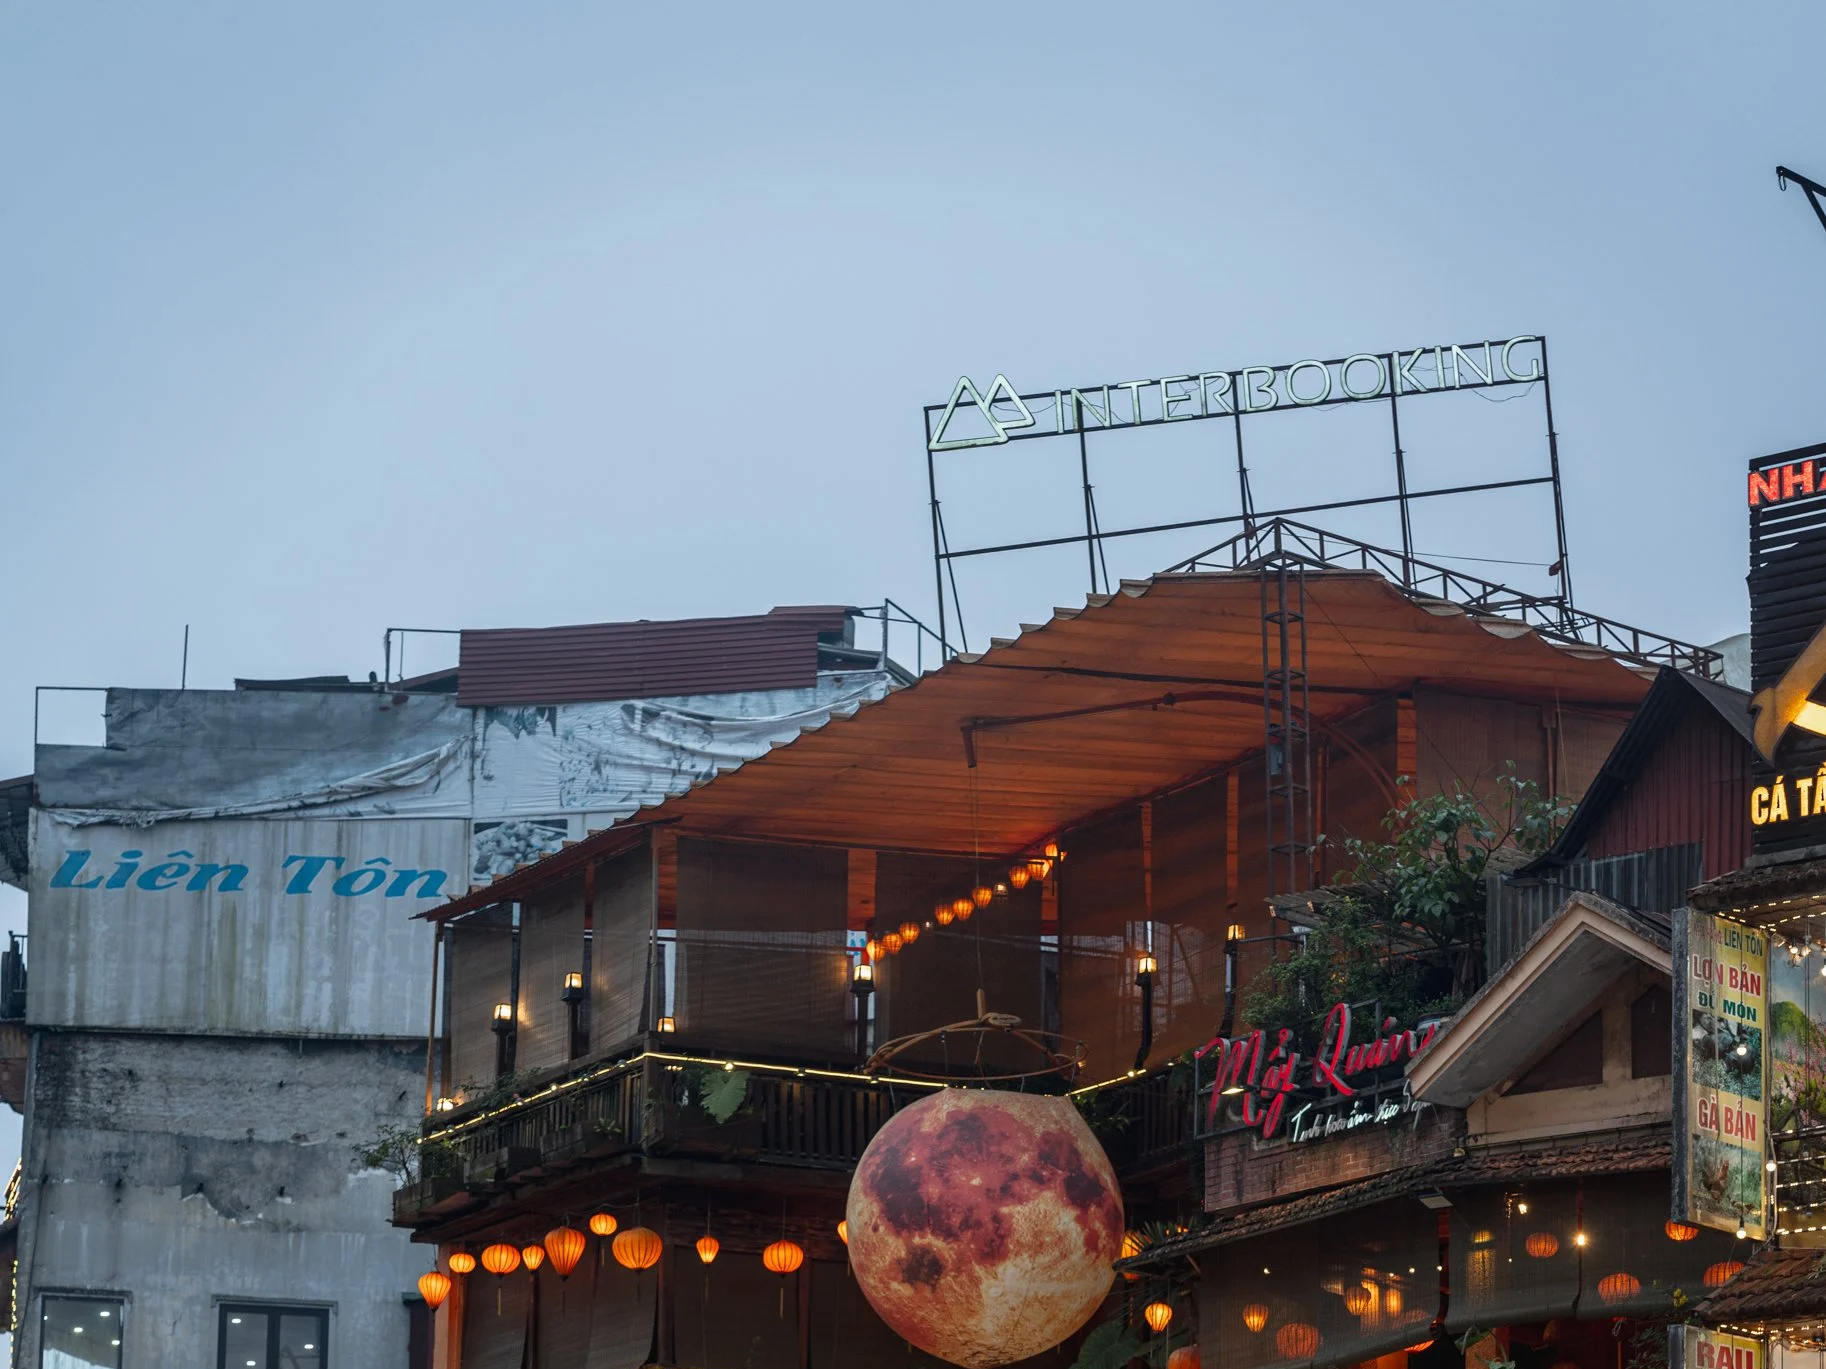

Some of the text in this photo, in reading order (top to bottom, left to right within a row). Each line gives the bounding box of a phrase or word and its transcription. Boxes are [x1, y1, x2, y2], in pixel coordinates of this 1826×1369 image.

[1054, 335, 1540, 434] INTERBOOKING
[1748, 459, 1826, 506] NH
[1751, 775, 1789, 826] CÁ
[50, 849, 448, 898] Liên Tôn
[1724, 926, 1742, 951] LIÊN
[1745, 931, 1763, 957] TÔN
[1728, 962, 1761, 997] BẢN
[1723, 999, 1757, 1022] MÓN
[1313, 1002, 1436, 1097] Quán
[1696, 1093, 1757, 1143] GÀ BẢN
